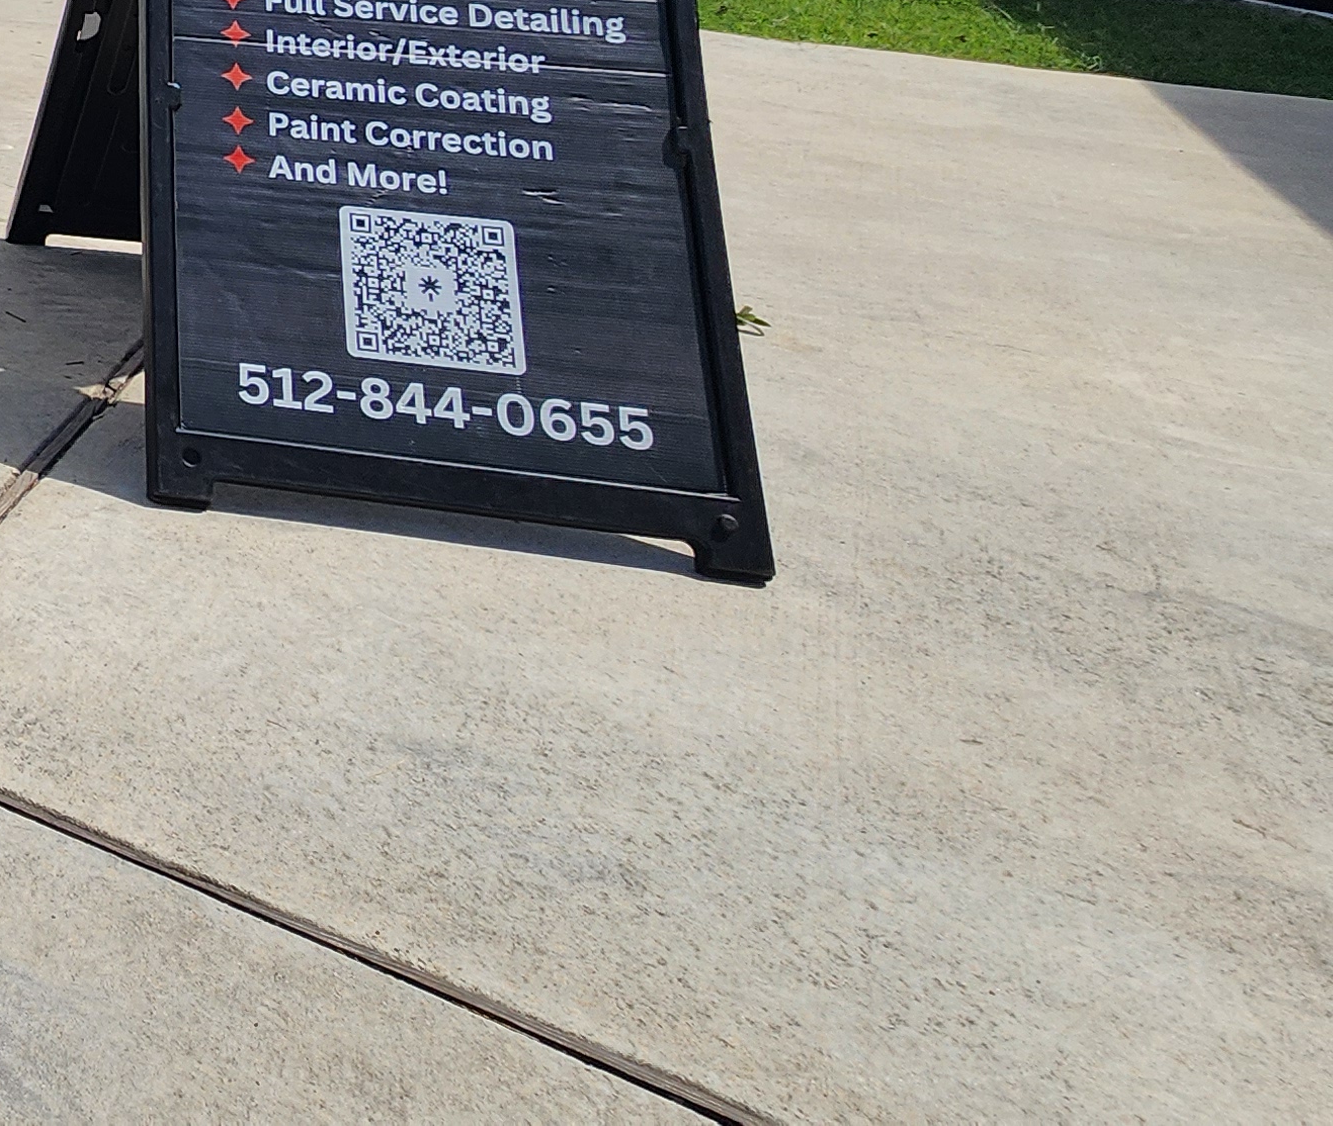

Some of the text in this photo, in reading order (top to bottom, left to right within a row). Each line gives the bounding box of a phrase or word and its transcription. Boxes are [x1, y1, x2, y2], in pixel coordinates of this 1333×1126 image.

[468, 3, 628, 44] Detailing
[266, 29, 546, 74] Interior/Exterior
[266, 70, 553, 123] Ceramic Coating
[268, 112, 554, 161] Paint Correction
[268, 155, 448, 195] And More!
[237, 362, 654, 451] 512-844-0655
